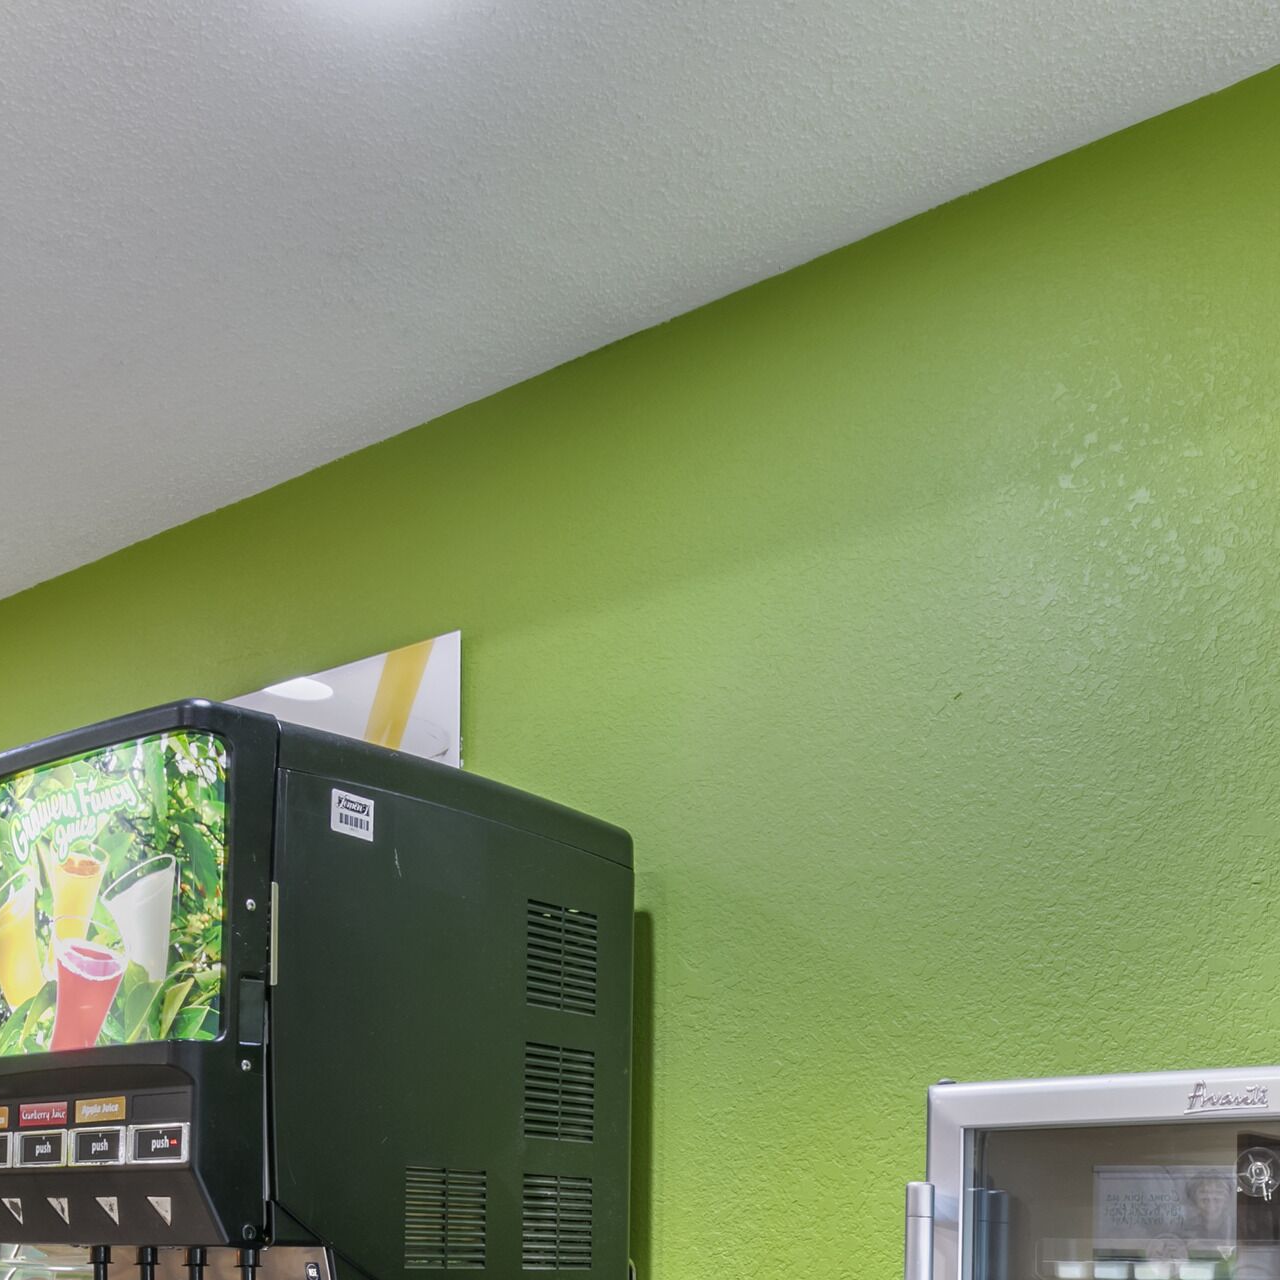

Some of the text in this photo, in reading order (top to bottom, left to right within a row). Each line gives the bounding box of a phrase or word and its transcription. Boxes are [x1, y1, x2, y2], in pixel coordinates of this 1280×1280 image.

[75, 776, 137, 816] Fancy
[1186, 1080, 1268, 1110] Avanti
[22, 1108, 65, 1120] Cranberry Juice
[102, 1103, 119, 1113] Juice
[35, 1141, 51, 1157] push
[91, 1138, 108, 1154] push
[151, 1135, 169, 1152] push
